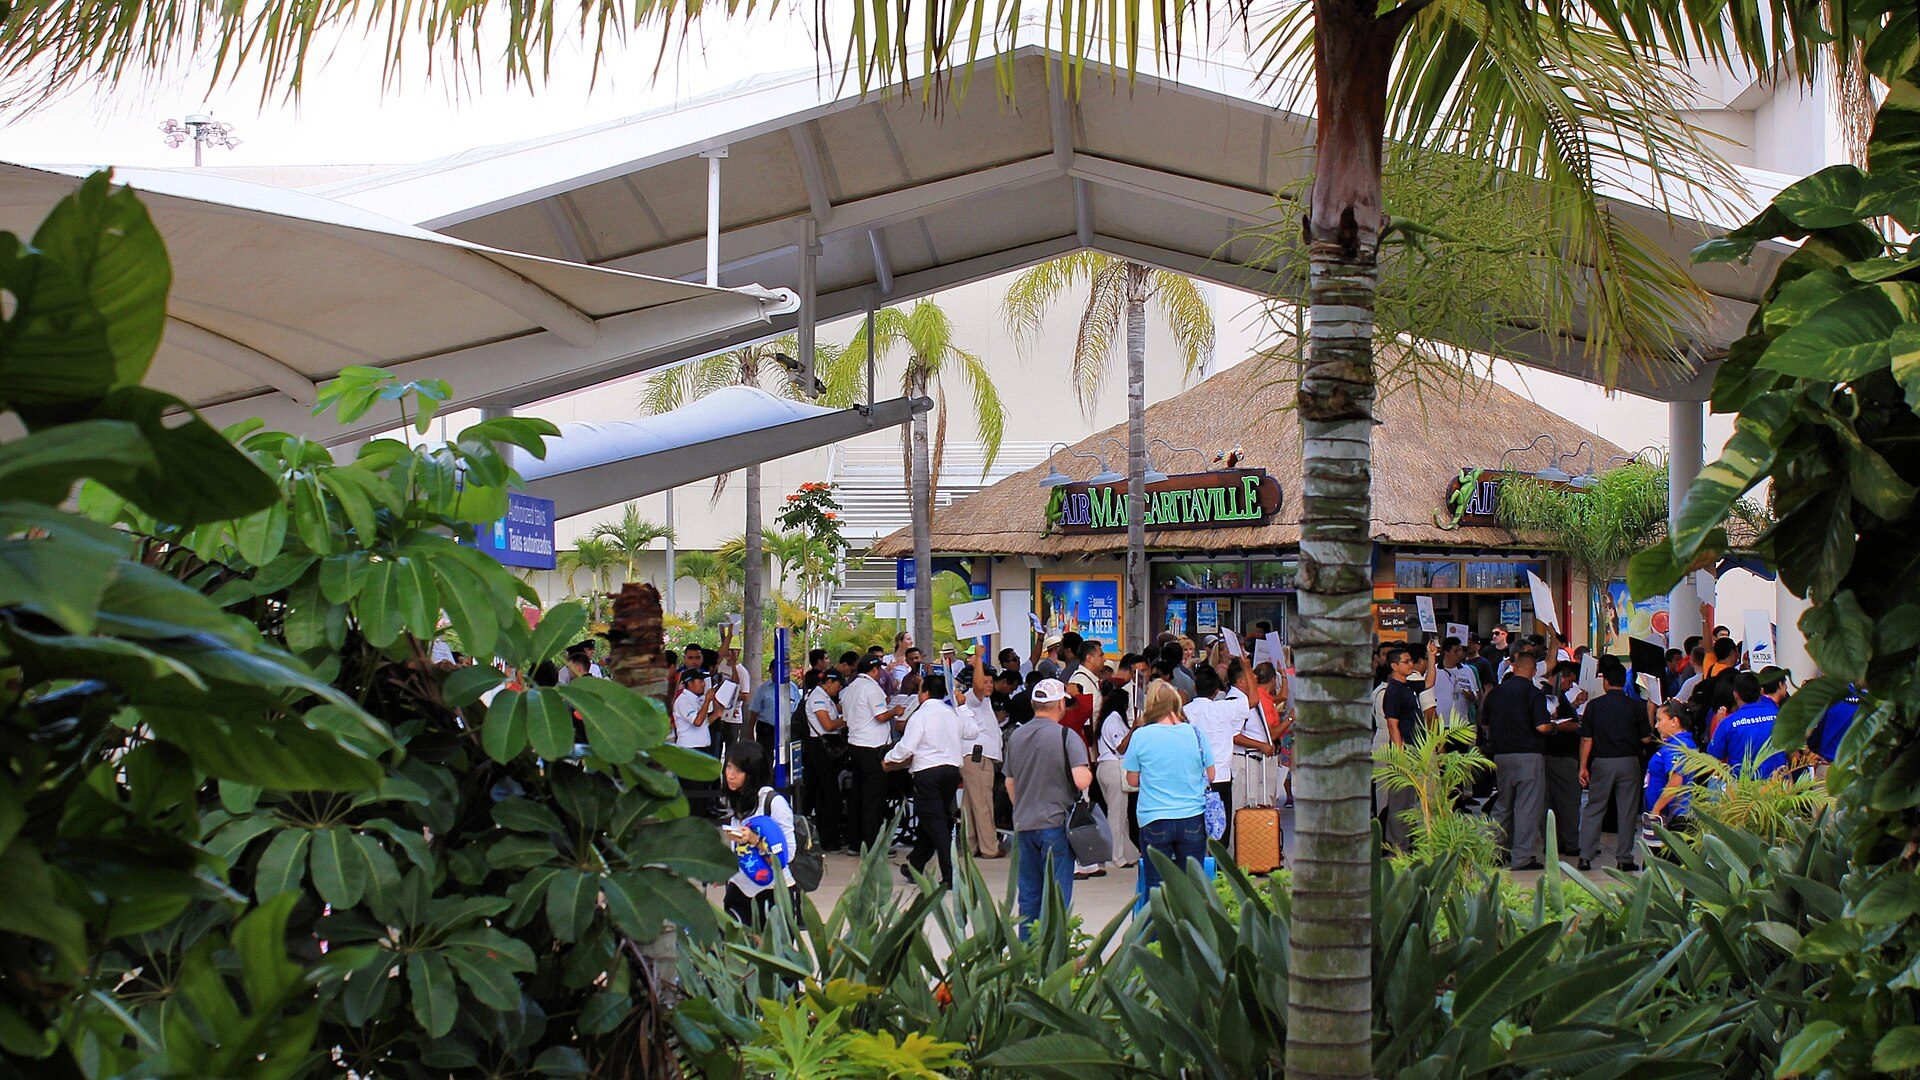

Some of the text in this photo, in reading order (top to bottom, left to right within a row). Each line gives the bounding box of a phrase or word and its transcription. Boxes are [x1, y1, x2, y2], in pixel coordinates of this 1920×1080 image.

[508, 498, 546, 526] Authorized taxis
[1060, 493, 1090, 525] AIR
[508, 527, 552, 556] Taxis autorizados
[1102, 608, 1112, 618] HEAR
[1089, 619, 1113, 634] A BEER
[1759, 652, 1772, 661] TOUR
